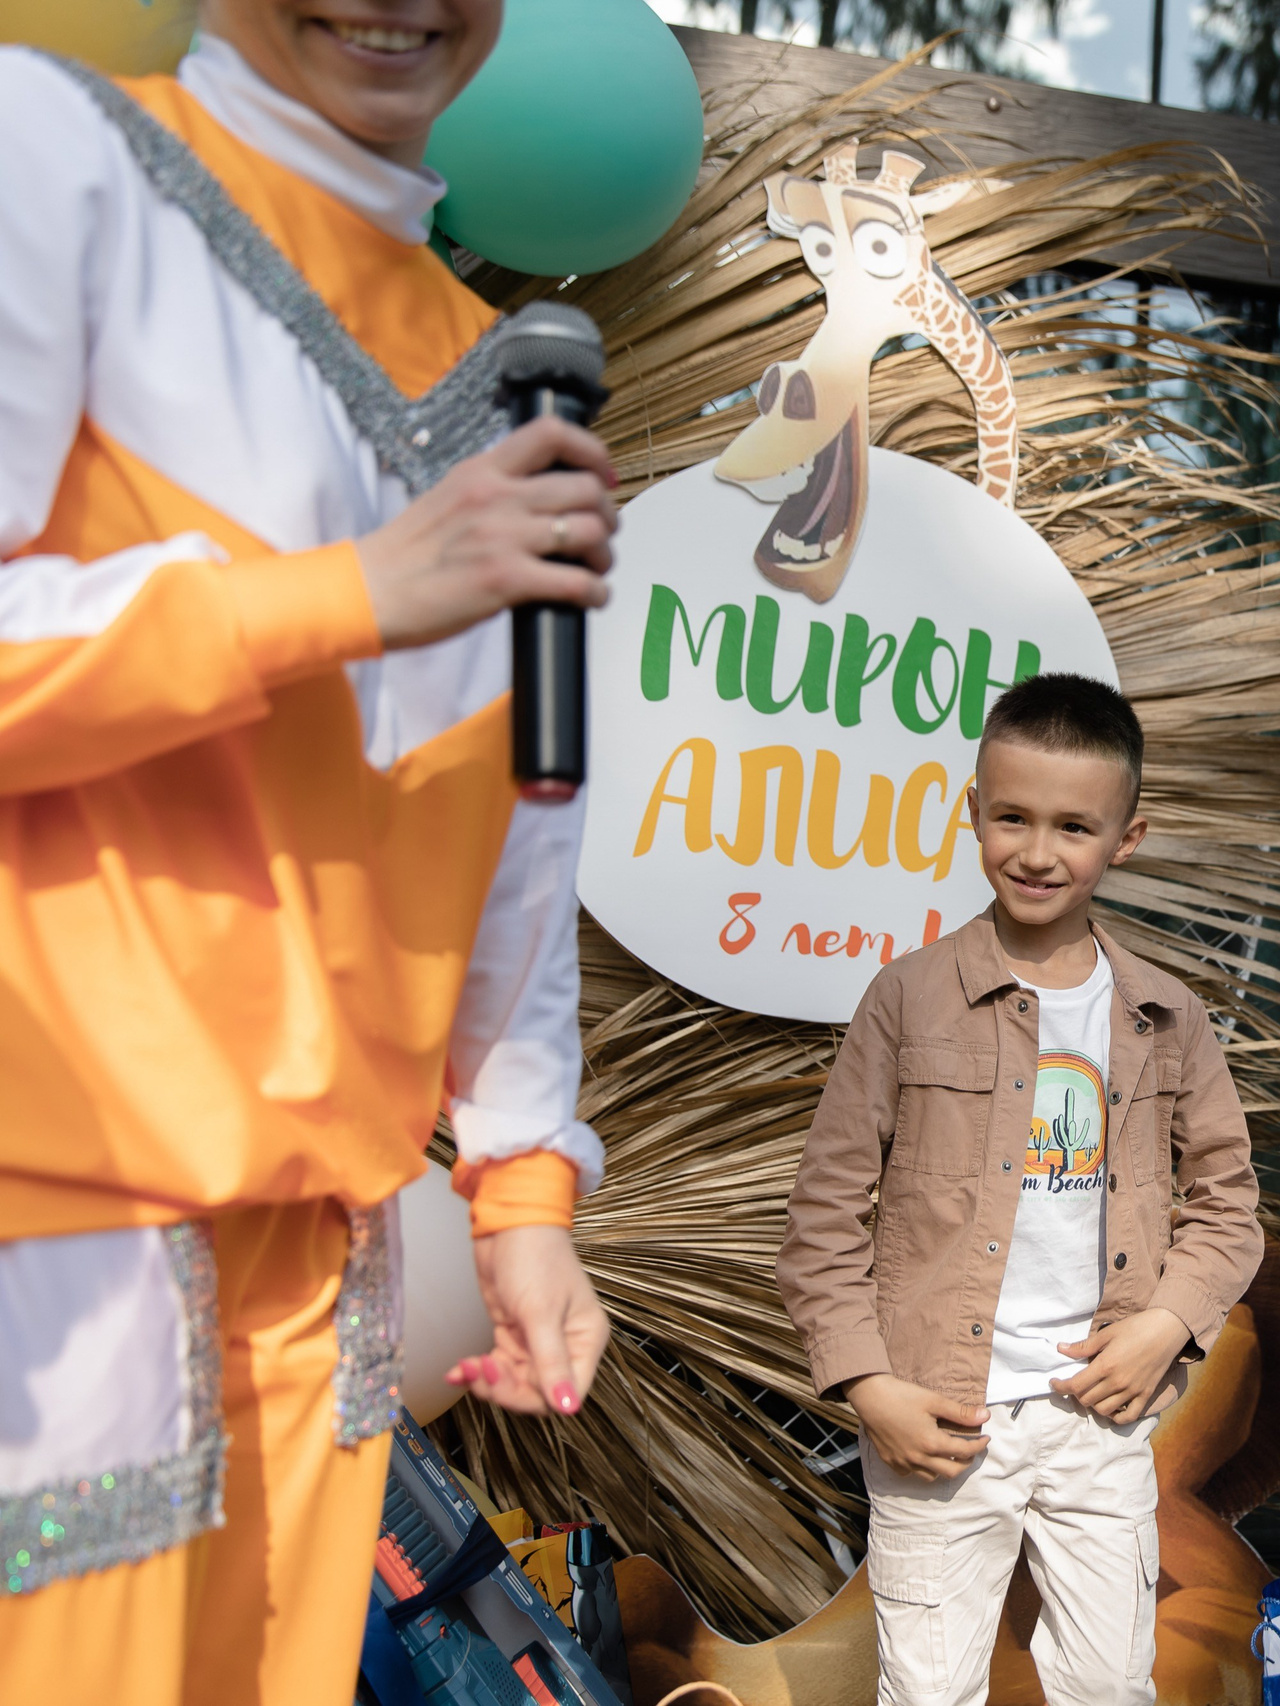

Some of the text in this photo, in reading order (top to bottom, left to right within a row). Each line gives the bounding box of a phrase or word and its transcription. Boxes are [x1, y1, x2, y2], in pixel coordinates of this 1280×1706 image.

[640, 583, 1041, 740] МИРОН
[718, 892, 762, 955] 8
[1047, 1163, 1105, 1194] Beach
